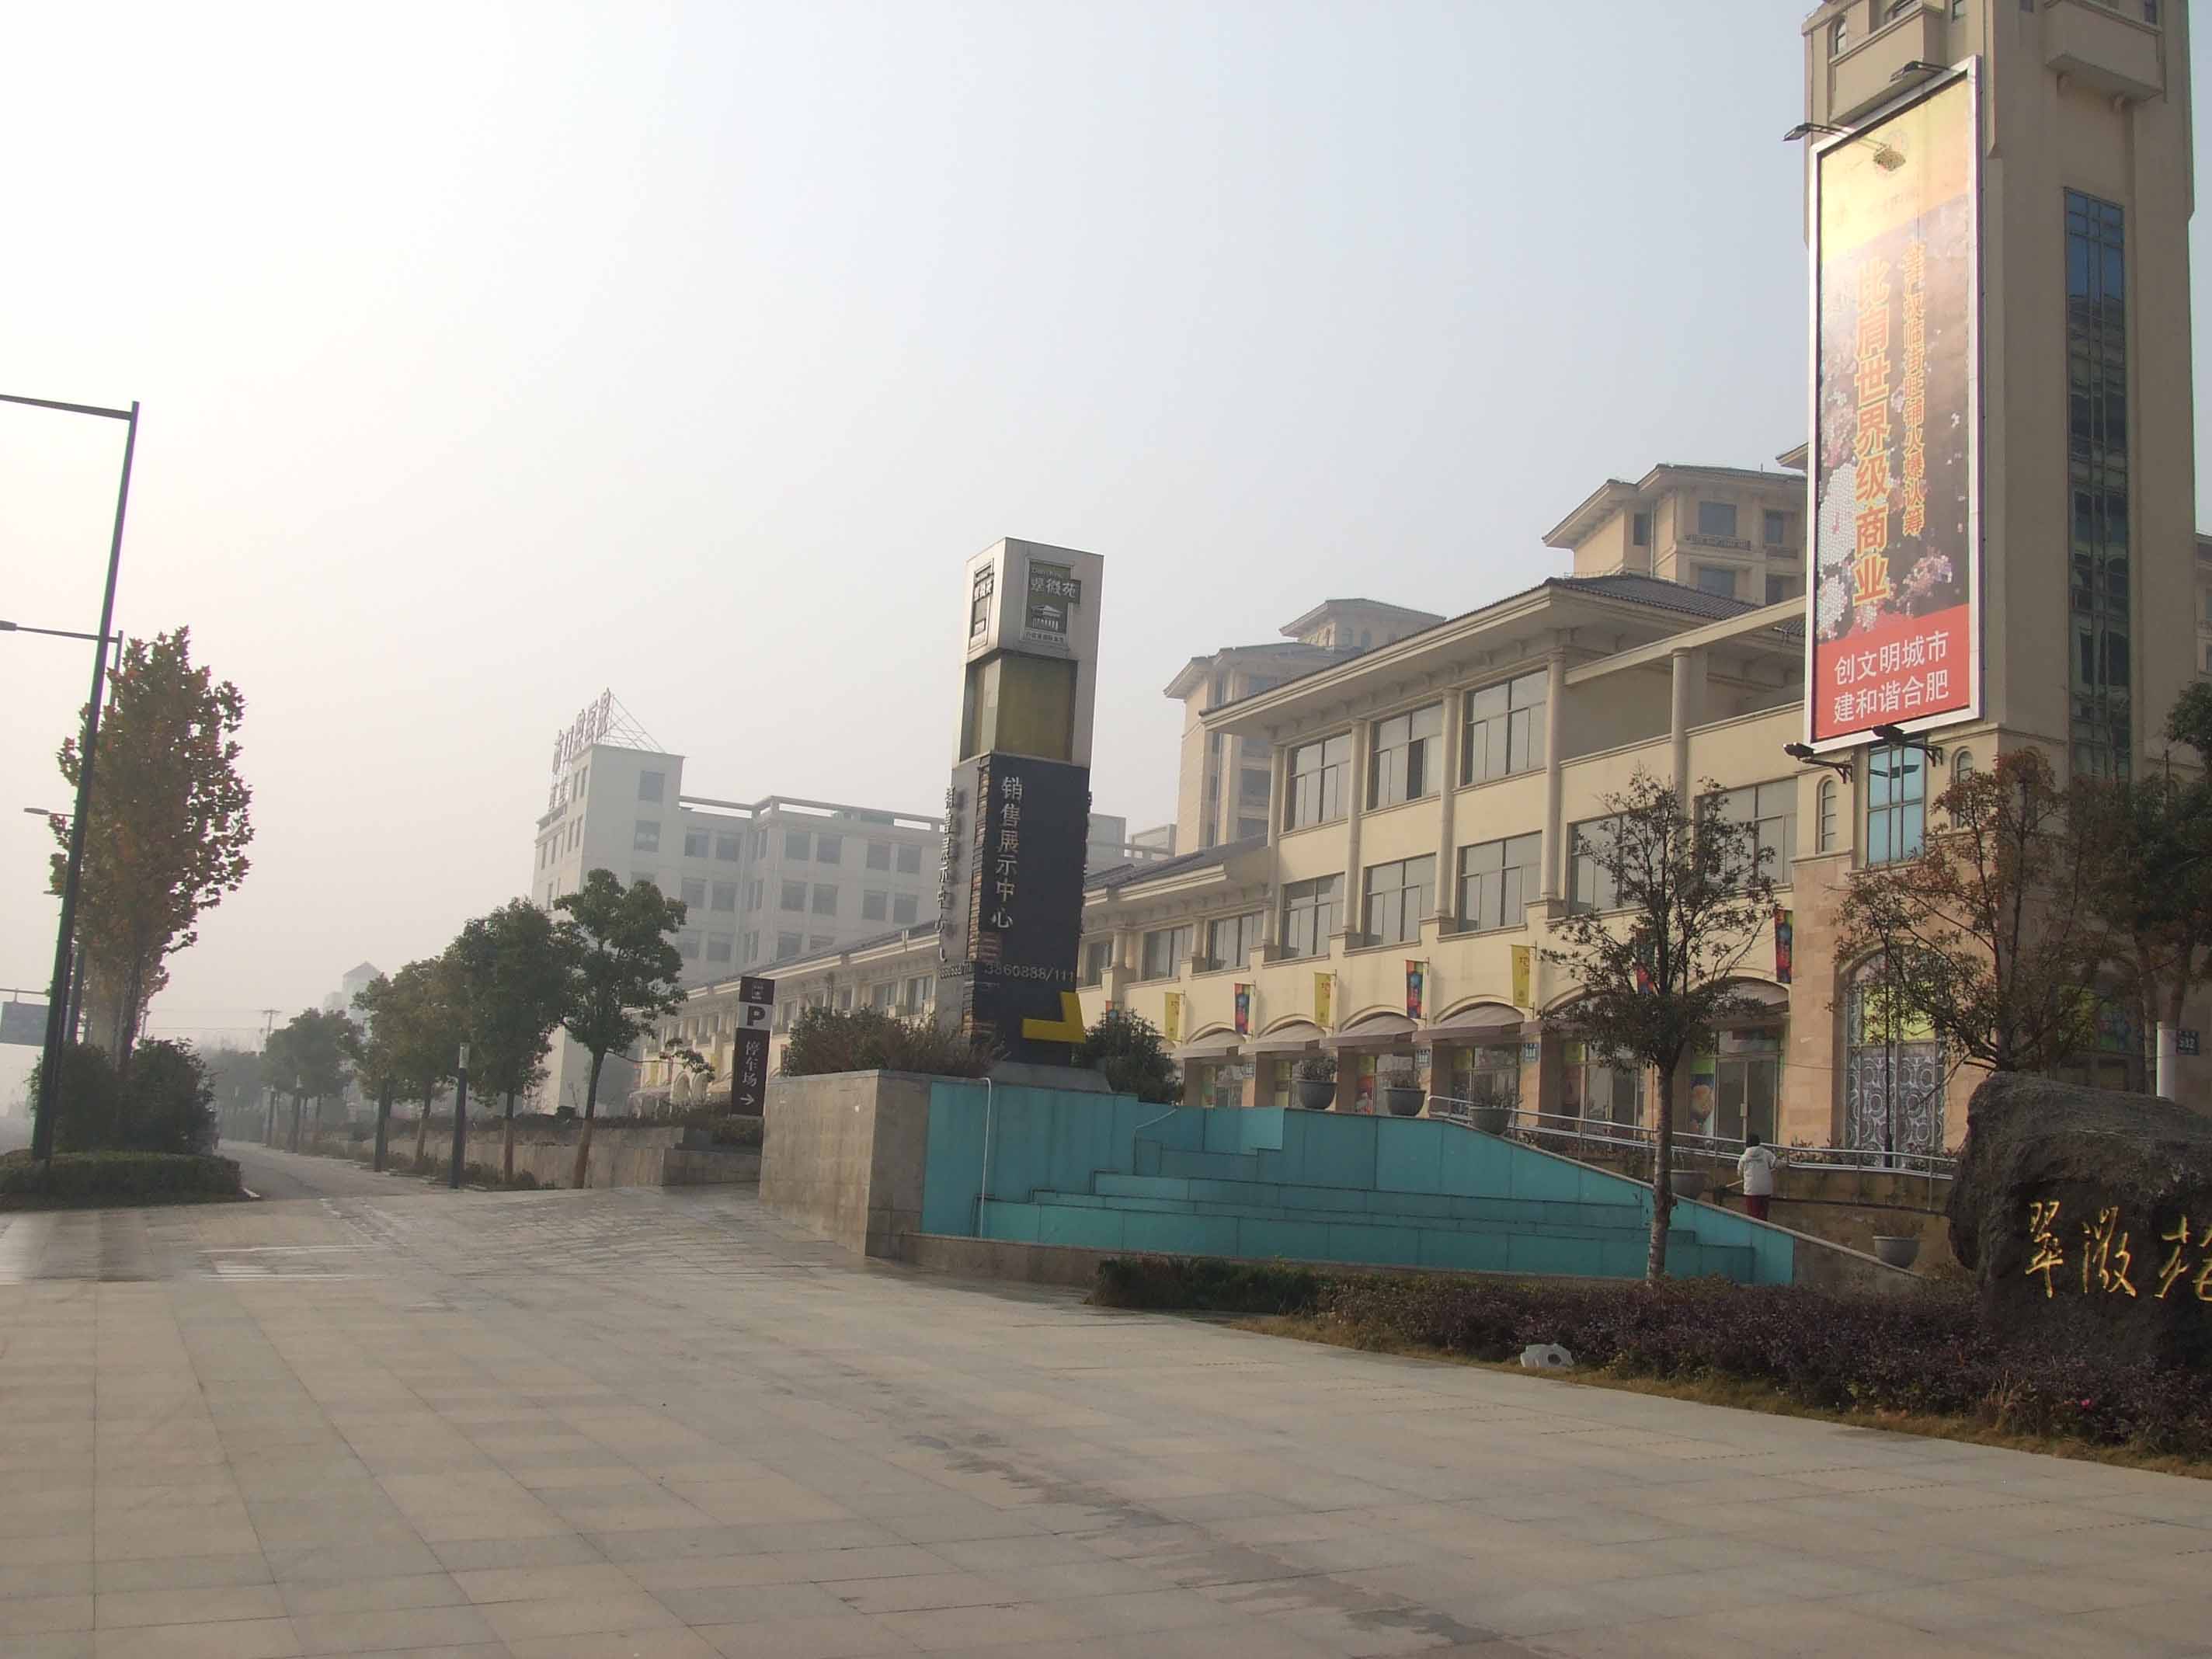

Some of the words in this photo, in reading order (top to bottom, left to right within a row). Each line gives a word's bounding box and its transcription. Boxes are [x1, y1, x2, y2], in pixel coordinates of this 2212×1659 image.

[1852, 257, 1890, 607] 比肩世界级商业
[1834, 631, 1949, 686] 创文明城市
[1834, 669, 1949, 724] 建和谐合肥
[991, 777, 1022, 929] 销售展示中心
[746, 1005, 766, 1026] P
[743, 1040, 760, 1087] 停车场
